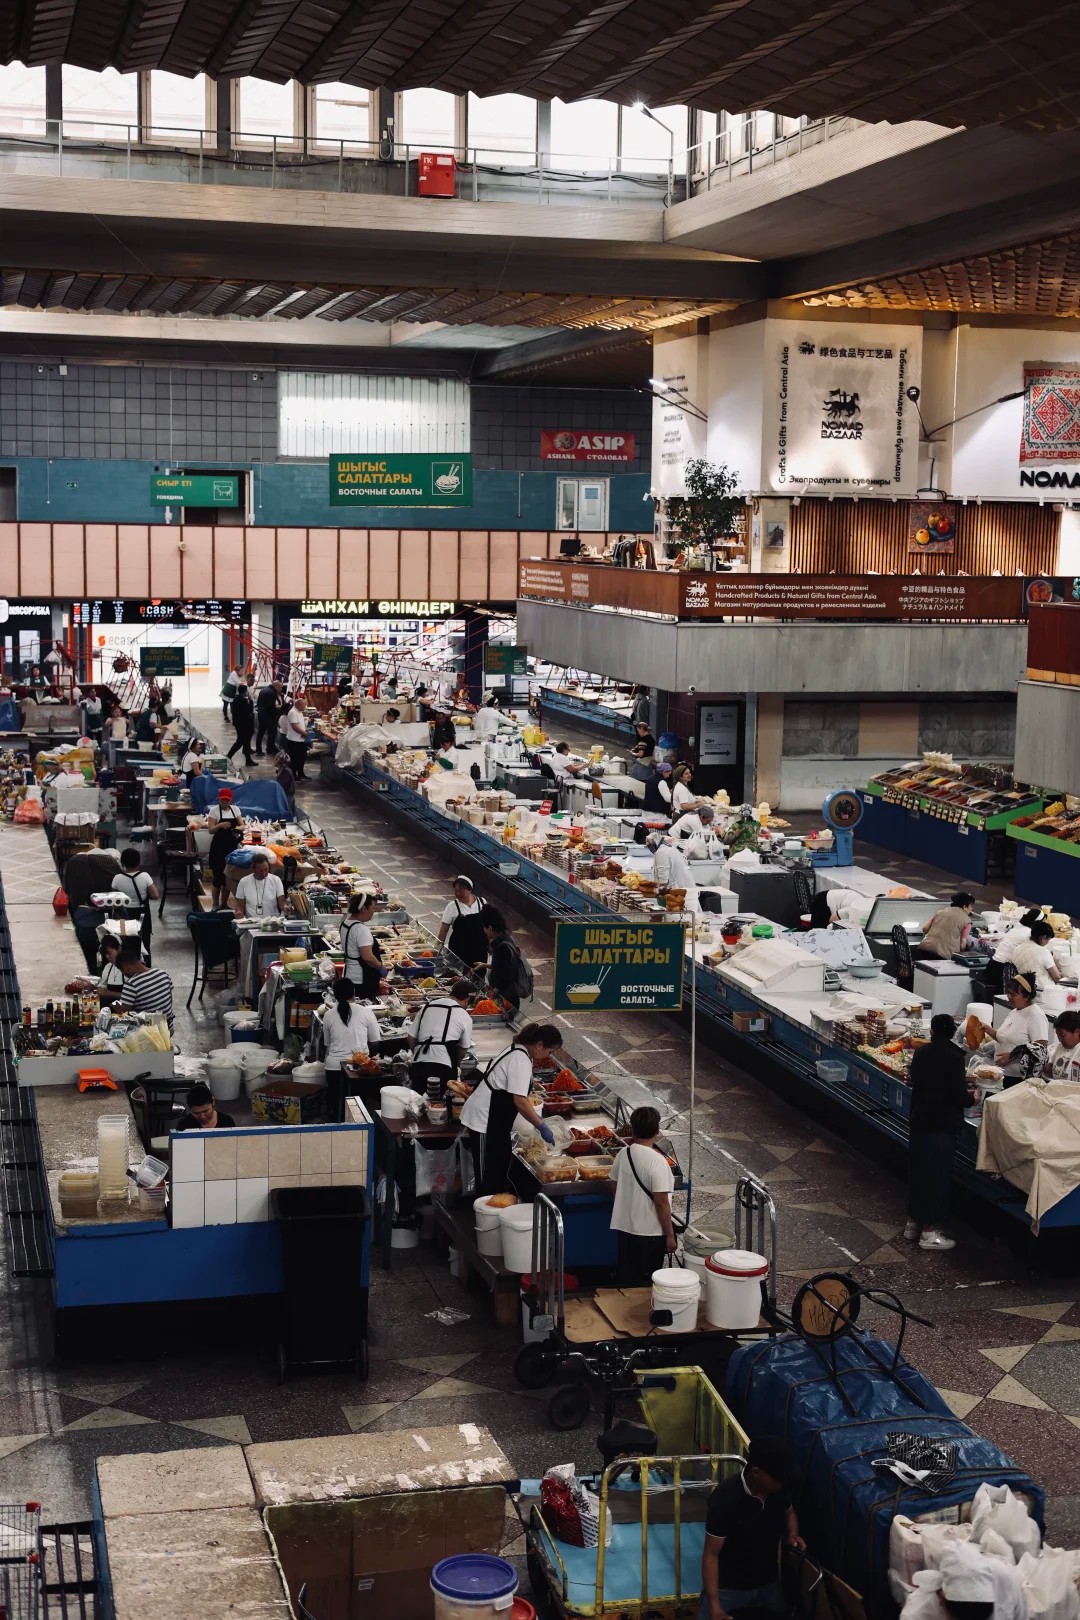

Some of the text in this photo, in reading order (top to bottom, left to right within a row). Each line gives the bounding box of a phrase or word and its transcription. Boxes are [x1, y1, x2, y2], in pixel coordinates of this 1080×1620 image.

[781, 346, 789, 366] Asia
[780, 367, 788, 399] Central
[821, 420, 864, 431] NOMAD
[577, 435, 625, 450] ASIP
[778, 425, 787, 447] Gifts
[821, 430, 862, 440] BAZAAR
[337, 474, 412, 484] САЛАТТАРЫ
[789, 475, 842, 485] Экопродукты
[852, 478, 890, 487] сувениры
[338, 488, 422, 496] ВОСТОЧНЫЕ САЛАТЫ
[378, 601, 454, 616] ӨНІМДЕРІ
[585, 929, 654, 944] ШЫҒЫС
[570, 948, 670, 964] САЛАТТАРЫ
